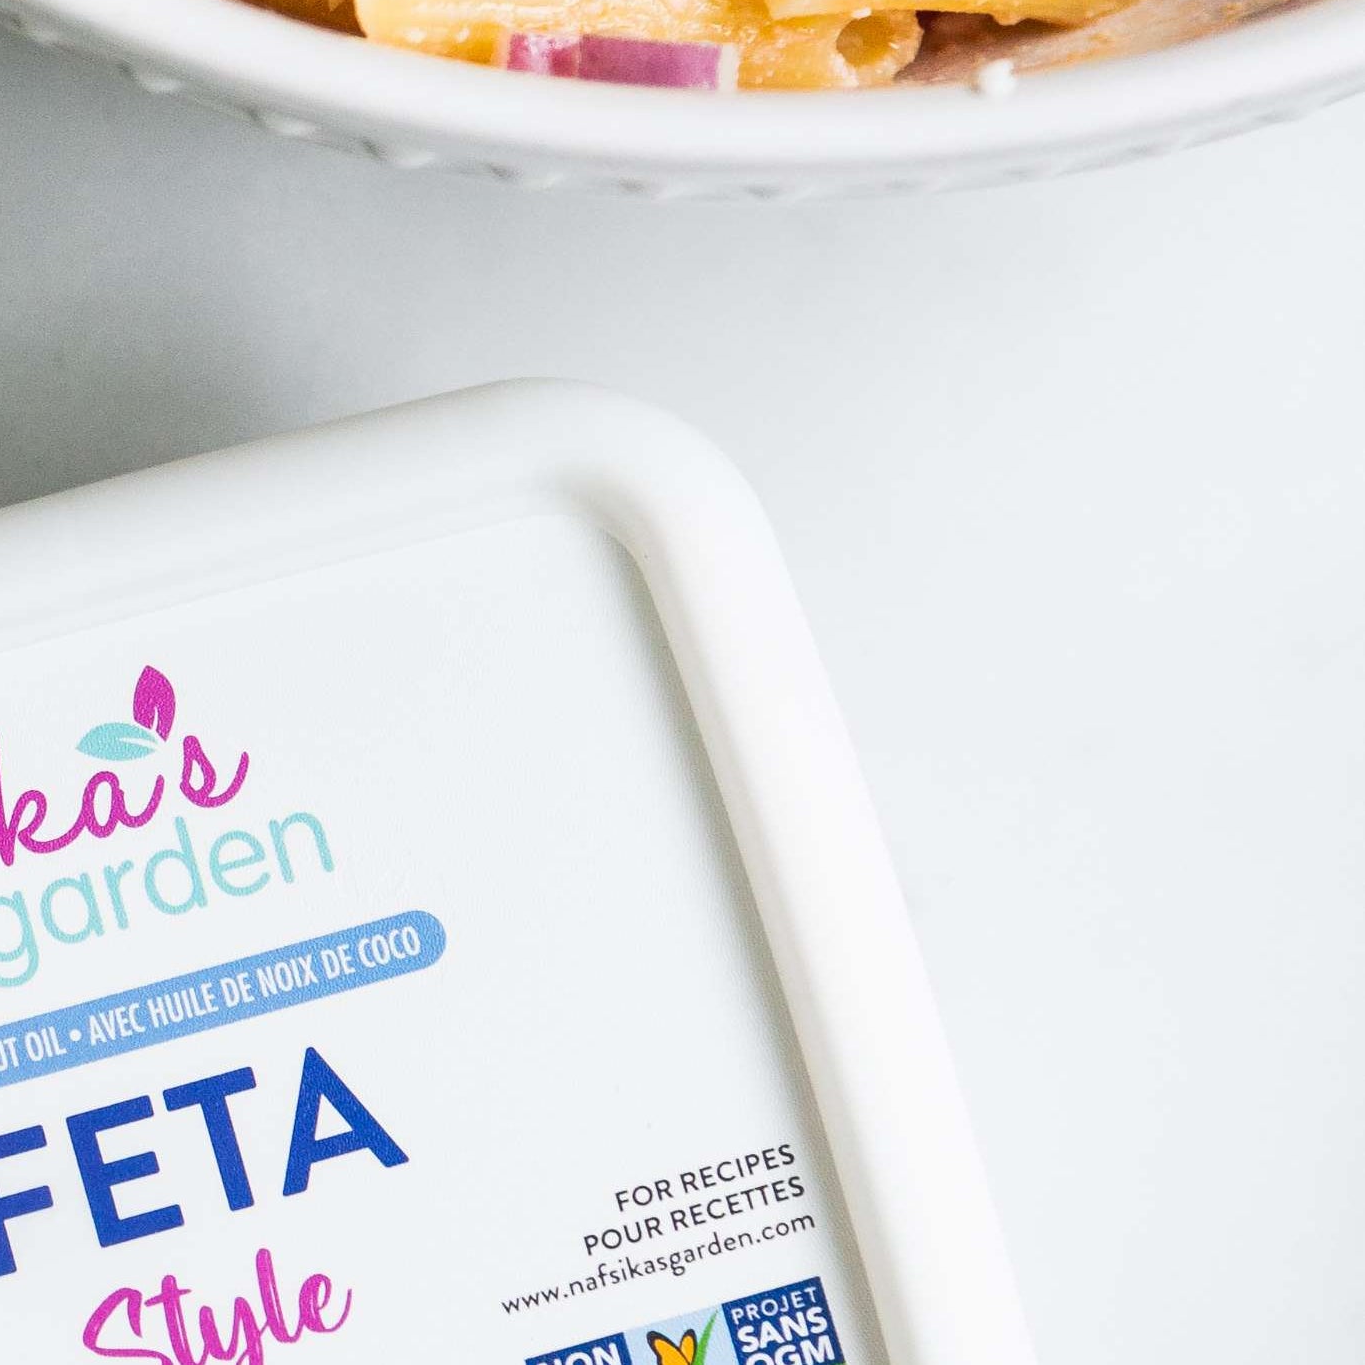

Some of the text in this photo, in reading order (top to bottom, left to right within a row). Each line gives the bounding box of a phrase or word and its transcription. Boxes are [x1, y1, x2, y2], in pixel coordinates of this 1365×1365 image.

[24, 1026, 68, 1062] OIL
[88, 1003, 146, 1047] AVEC
[146, 982, 220, 1030] HUILE
[220, 972, 257, 1008] DE
[255, 953, 319, 998] NOIX
[320, 944, 357, 980] DE
[356, 925, 422, 969] COCO
[583, 1175, 806, 1256] POUR RECETTES
[614, 1143, 796, 1212] FOR RECIPES
[501, 1214, 816, 1314] www.nafsikasgarden.com
[82, 1247, 352, 1365] Style
[730, 1286, 817, 1325] PROJET
[736, 1306, 828, 1353] SANS
